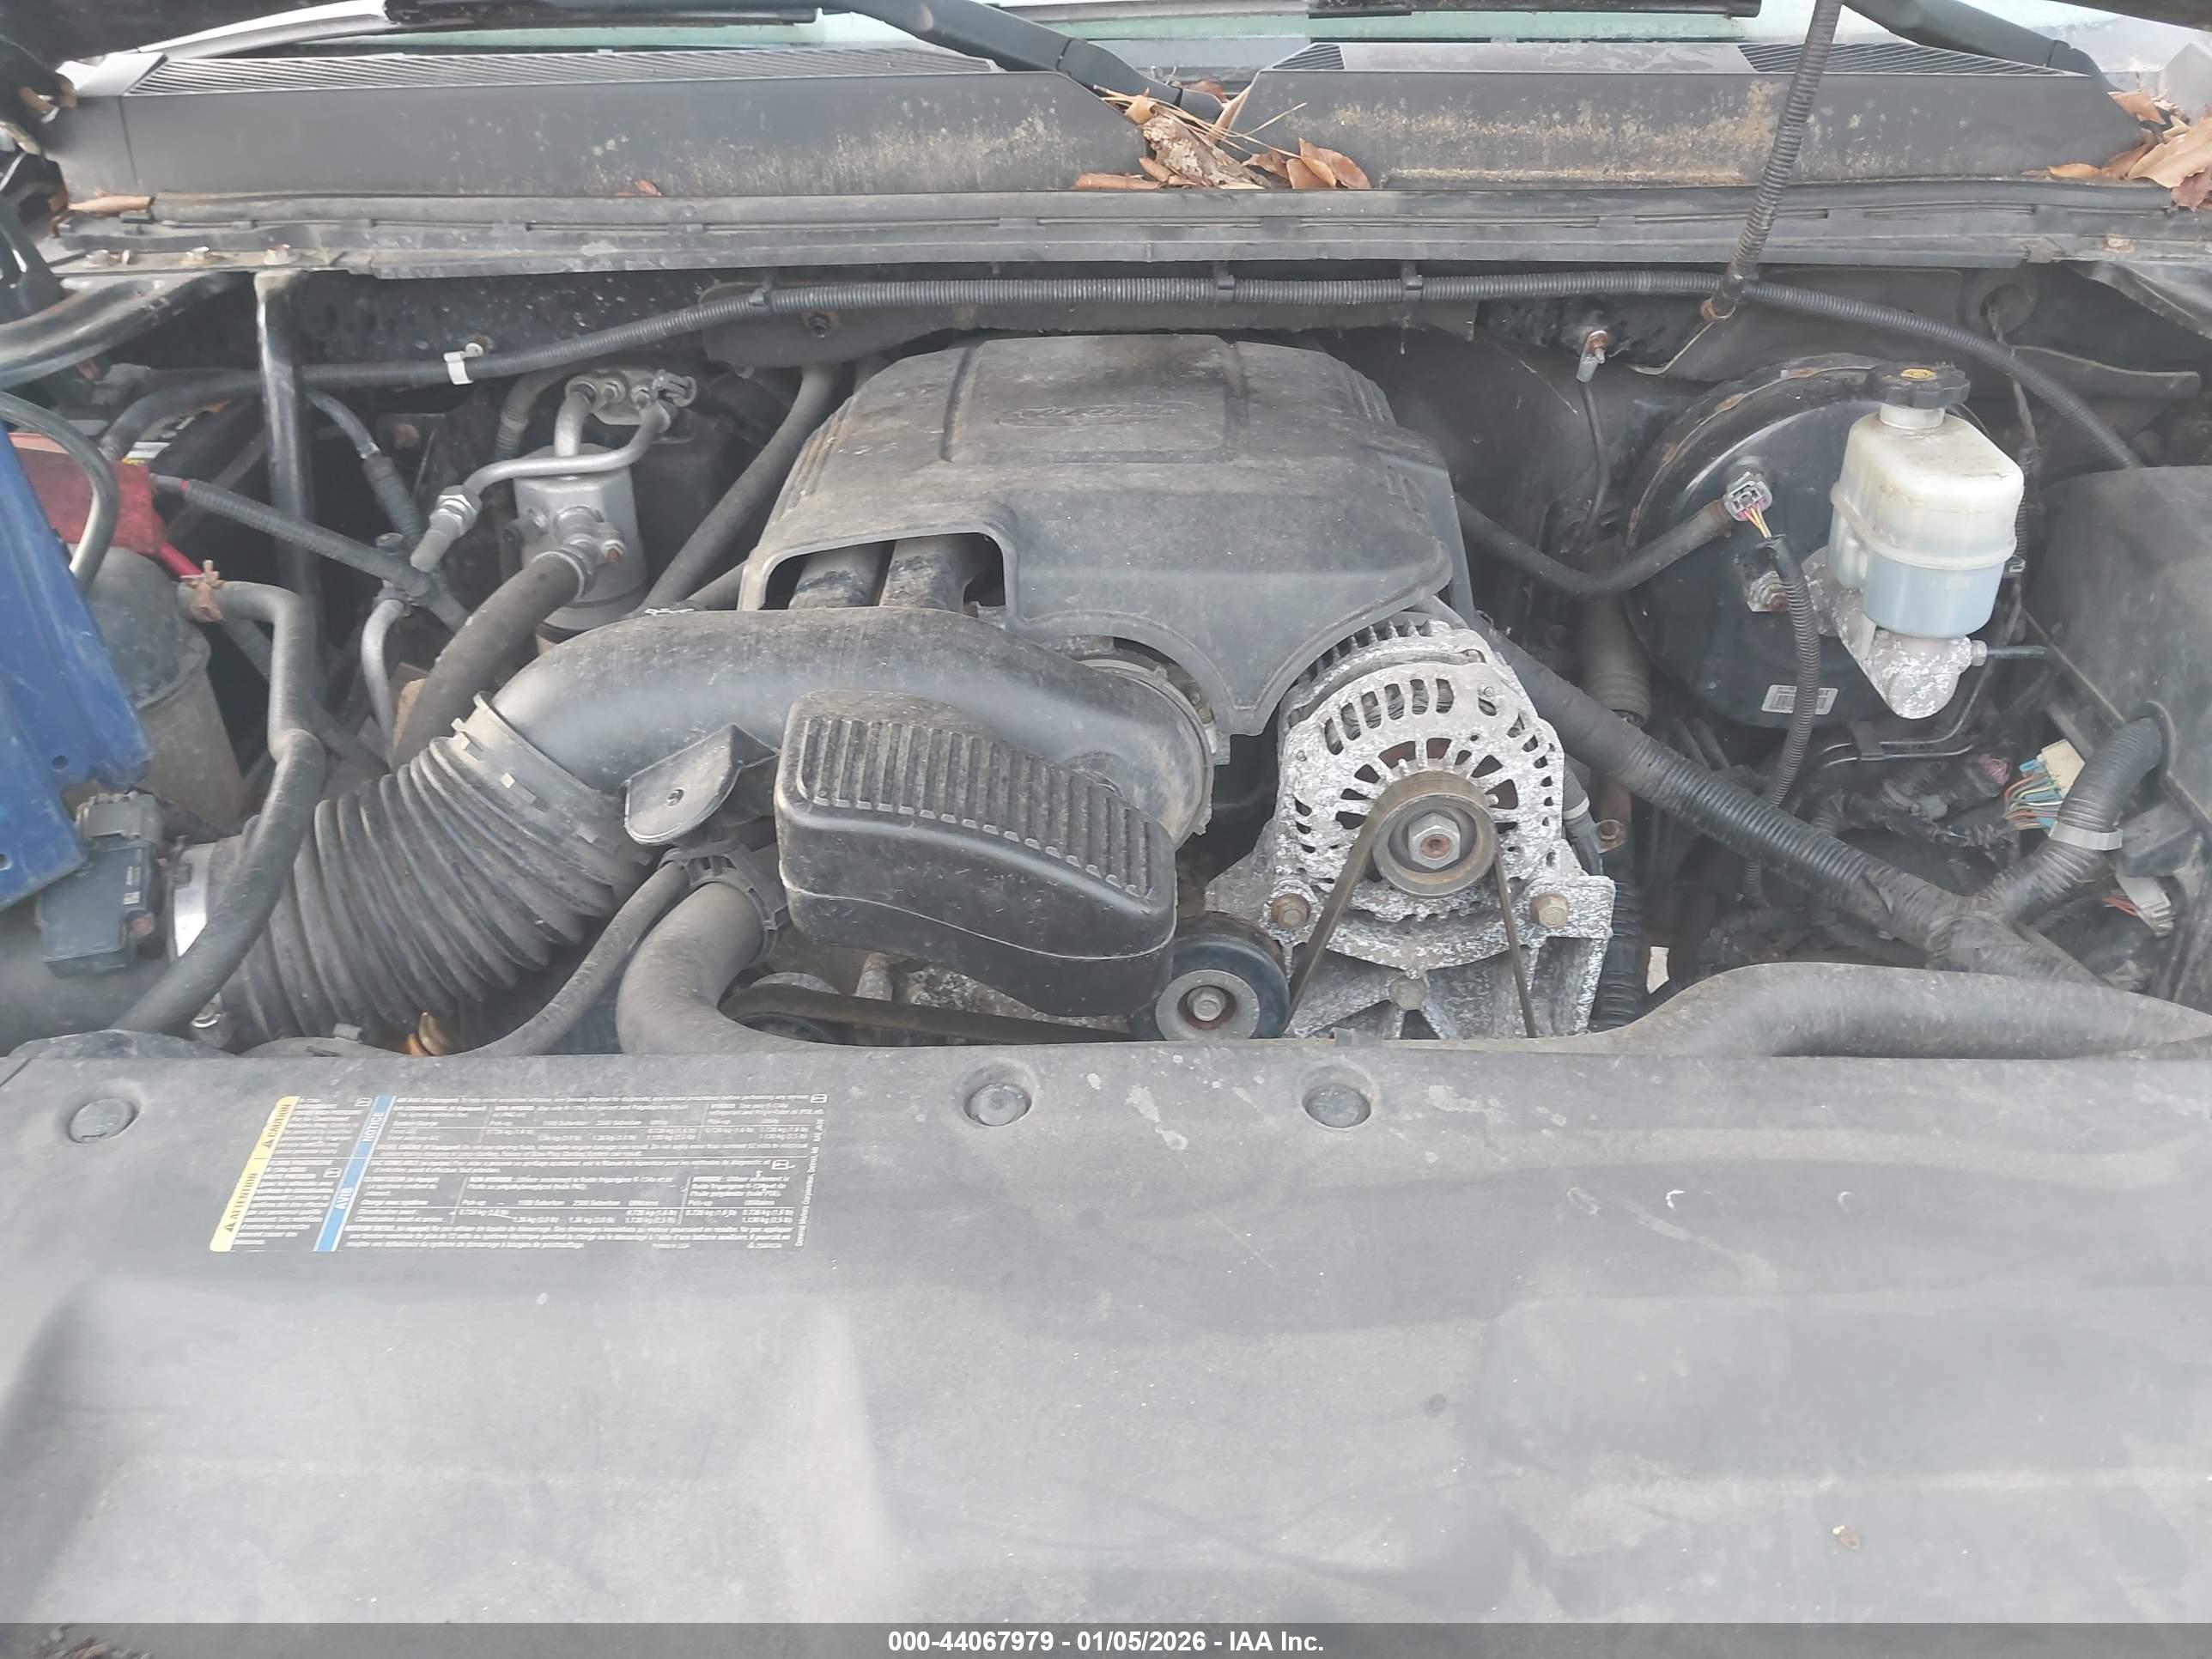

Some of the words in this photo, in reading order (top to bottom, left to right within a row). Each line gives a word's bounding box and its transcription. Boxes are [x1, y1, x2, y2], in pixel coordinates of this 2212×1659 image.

[267, 1104, 292, 1138] CAUTION
[361, 1112, 386, 1143] NOTICE
[229, 1173, 258, 1220] ATTENTION
[334, 1187, 354, 1210] AVIS
